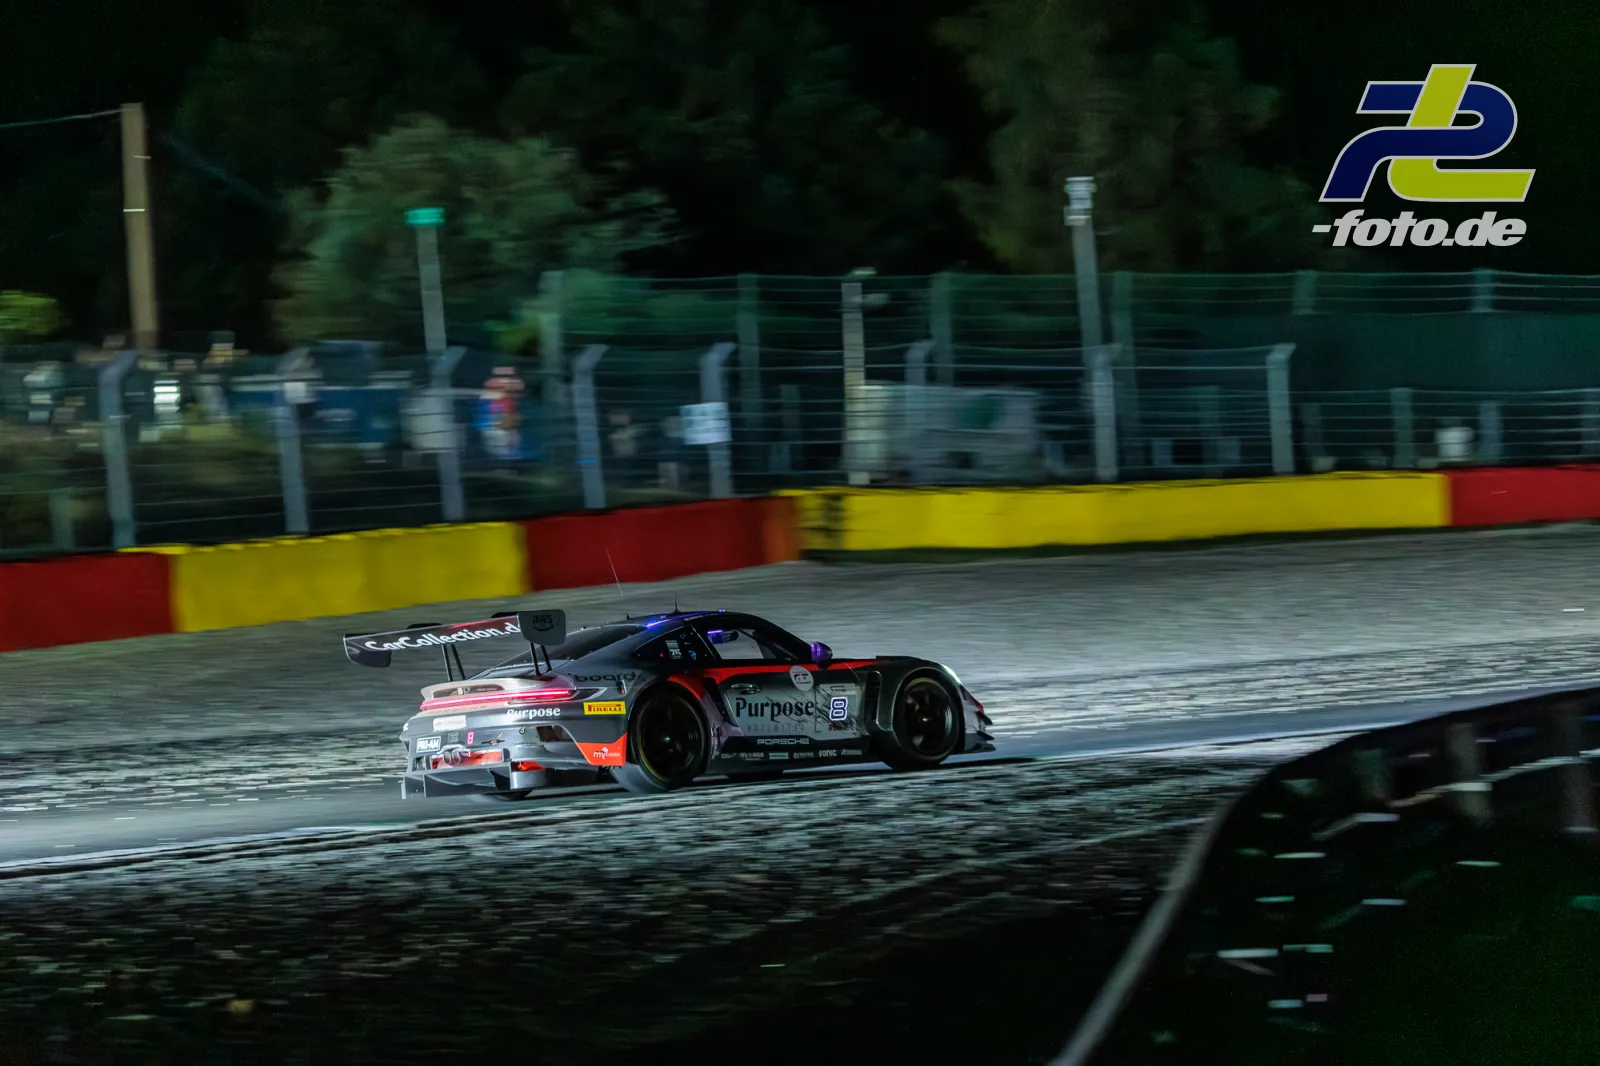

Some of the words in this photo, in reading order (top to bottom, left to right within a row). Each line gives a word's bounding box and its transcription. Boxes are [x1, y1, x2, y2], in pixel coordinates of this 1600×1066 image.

[532, 614, 553, 624] aws
[506, 708, 561, 720] Purpose
[588, 704, 622, 712] PIRELLI
[735, 697, 815, 721] Purpose
[829, 696, 848, 721] 8
[417, 739, 439, 751] PRO-AM
